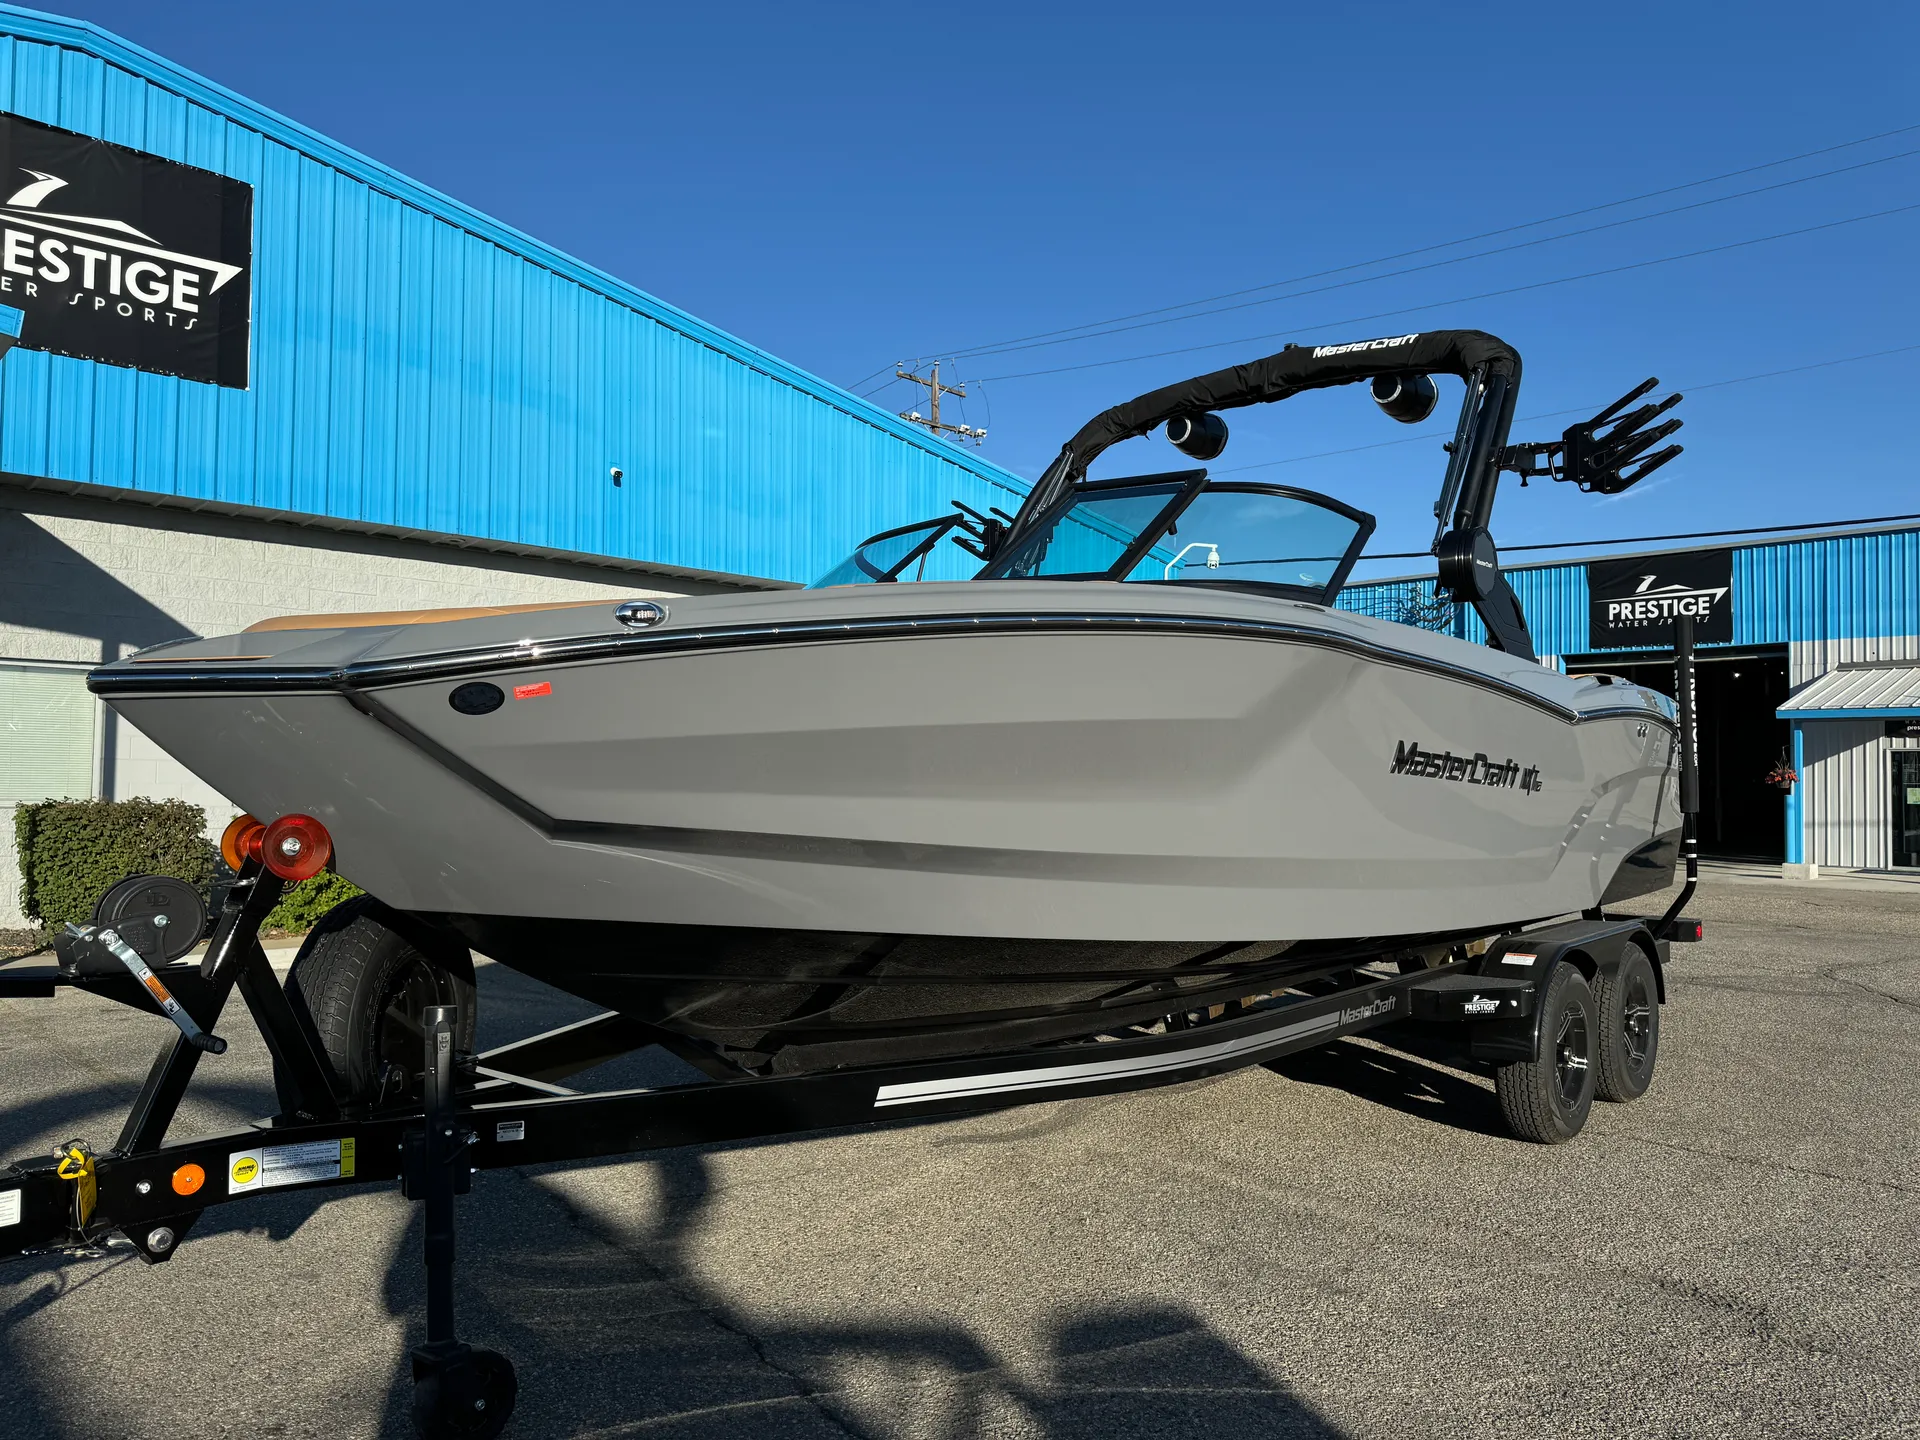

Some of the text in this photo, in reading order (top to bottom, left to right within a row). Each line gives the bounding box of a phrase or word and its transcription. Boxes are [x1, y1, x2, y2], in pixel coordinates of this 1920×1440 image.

[69, 293, 198, 329] SPORTS
[1312, 333, 1419, 358] MasterCraft
[1609, 597, 1710, 620] PRESTIGE
[1609, 616, 1709, 628] WATER SPTS
[1390, 740, 1519, 788] MasterCraft
[1340, 995, 1397, 1026] MasterCraft
[1465, 1003, 1495, 1011] PRESTIGE
